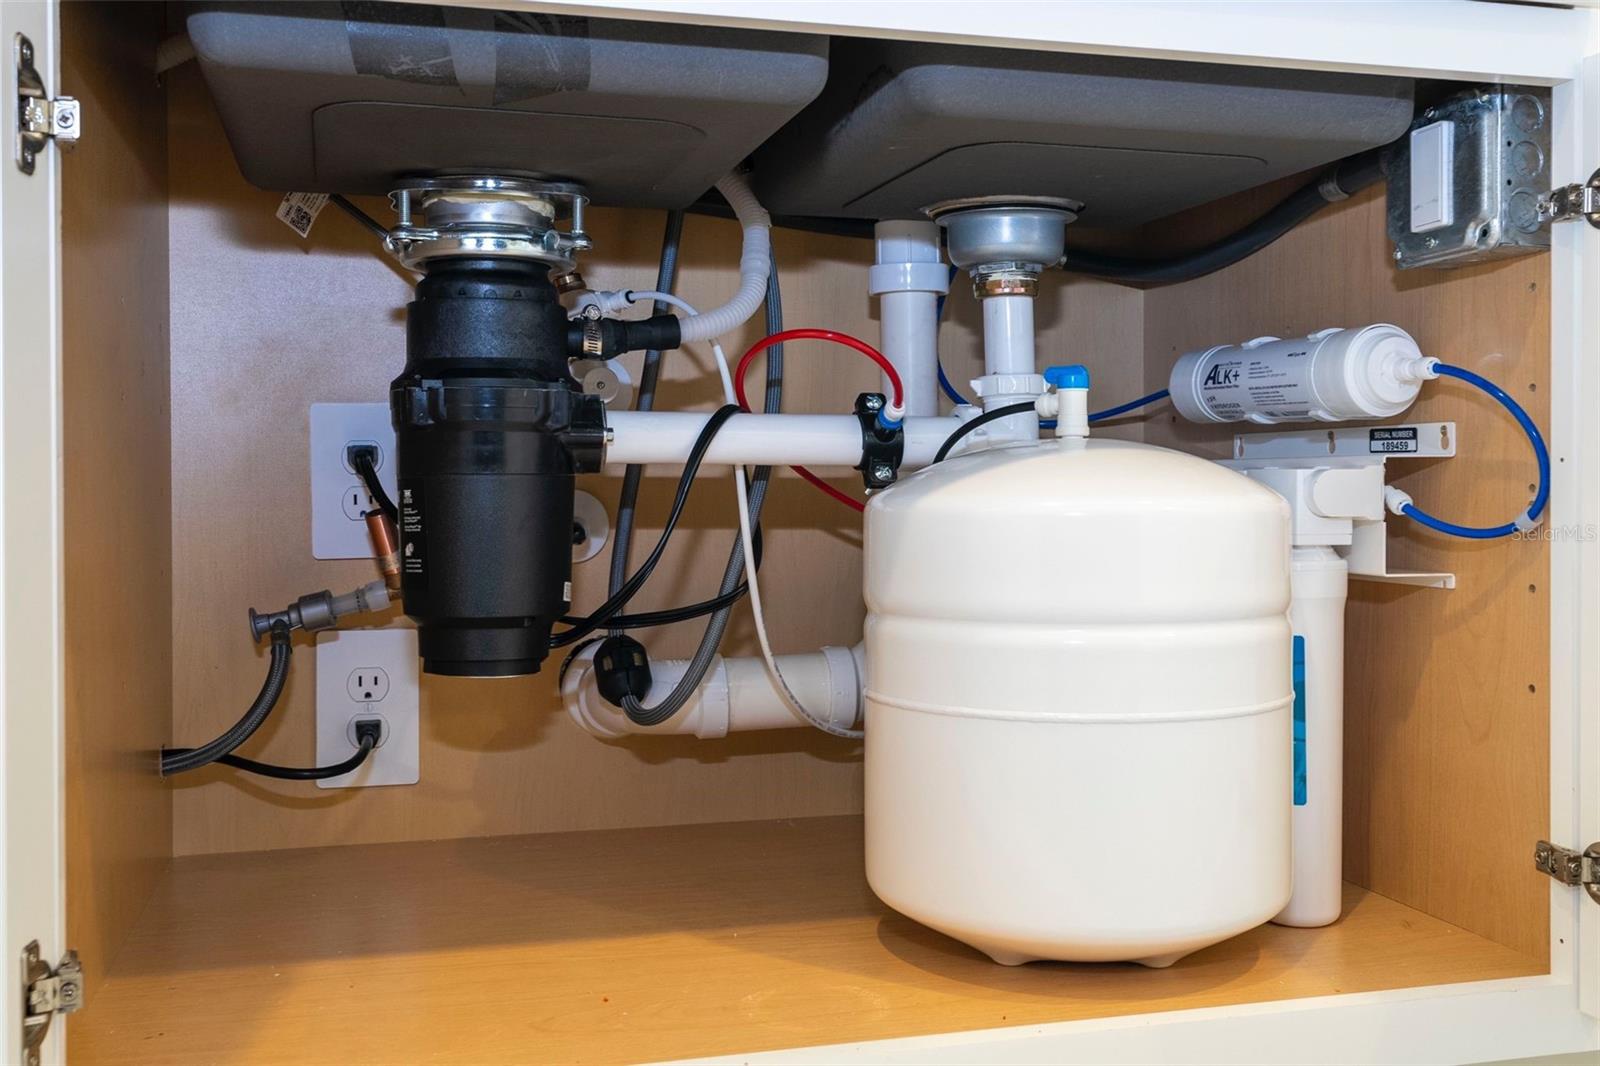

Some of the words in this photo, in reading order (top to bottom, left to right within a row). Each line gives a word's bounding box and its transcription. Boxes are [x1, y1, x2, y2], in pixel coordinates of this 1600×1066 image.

[1204, 364, 1240, 386] ALK+
[1374, 431, 1391, 439] SERIAL
[1391, 430, 1414, 438] NUMBER
[1382, 441, 1409, 450] 189459
